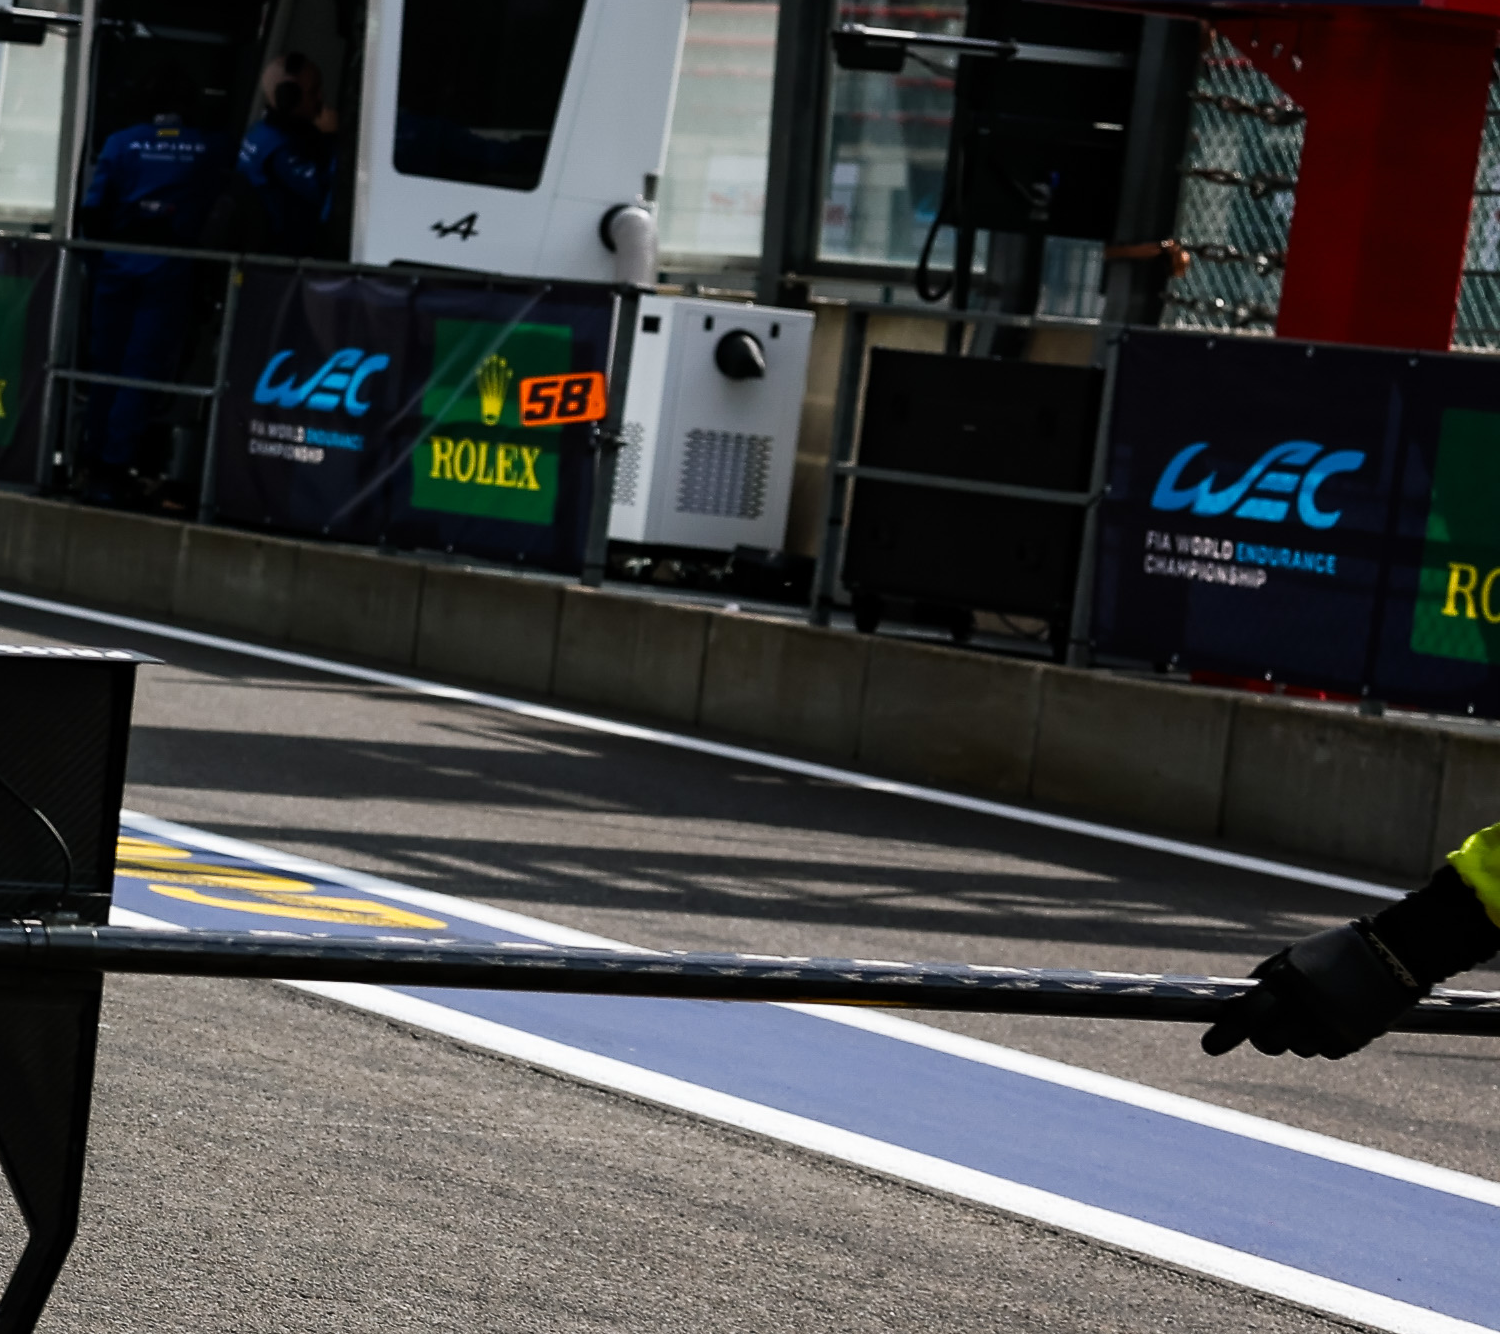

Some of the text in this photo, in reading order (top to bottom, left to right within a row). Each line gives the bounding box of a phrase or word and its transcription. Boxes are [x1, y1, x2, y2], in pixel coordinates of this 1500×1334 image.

[253, 347, 391, 417] WEC
[524, 377, 594, 422] 58
[429, 435, 543, 491] ROLEX
[1150, 439, 1367, 530] WEC
[1143, 552, 1269, 590] CHAMPIONSHIP
[1144, 529, 1338, 576] FIA WORLD ENDURANCE
